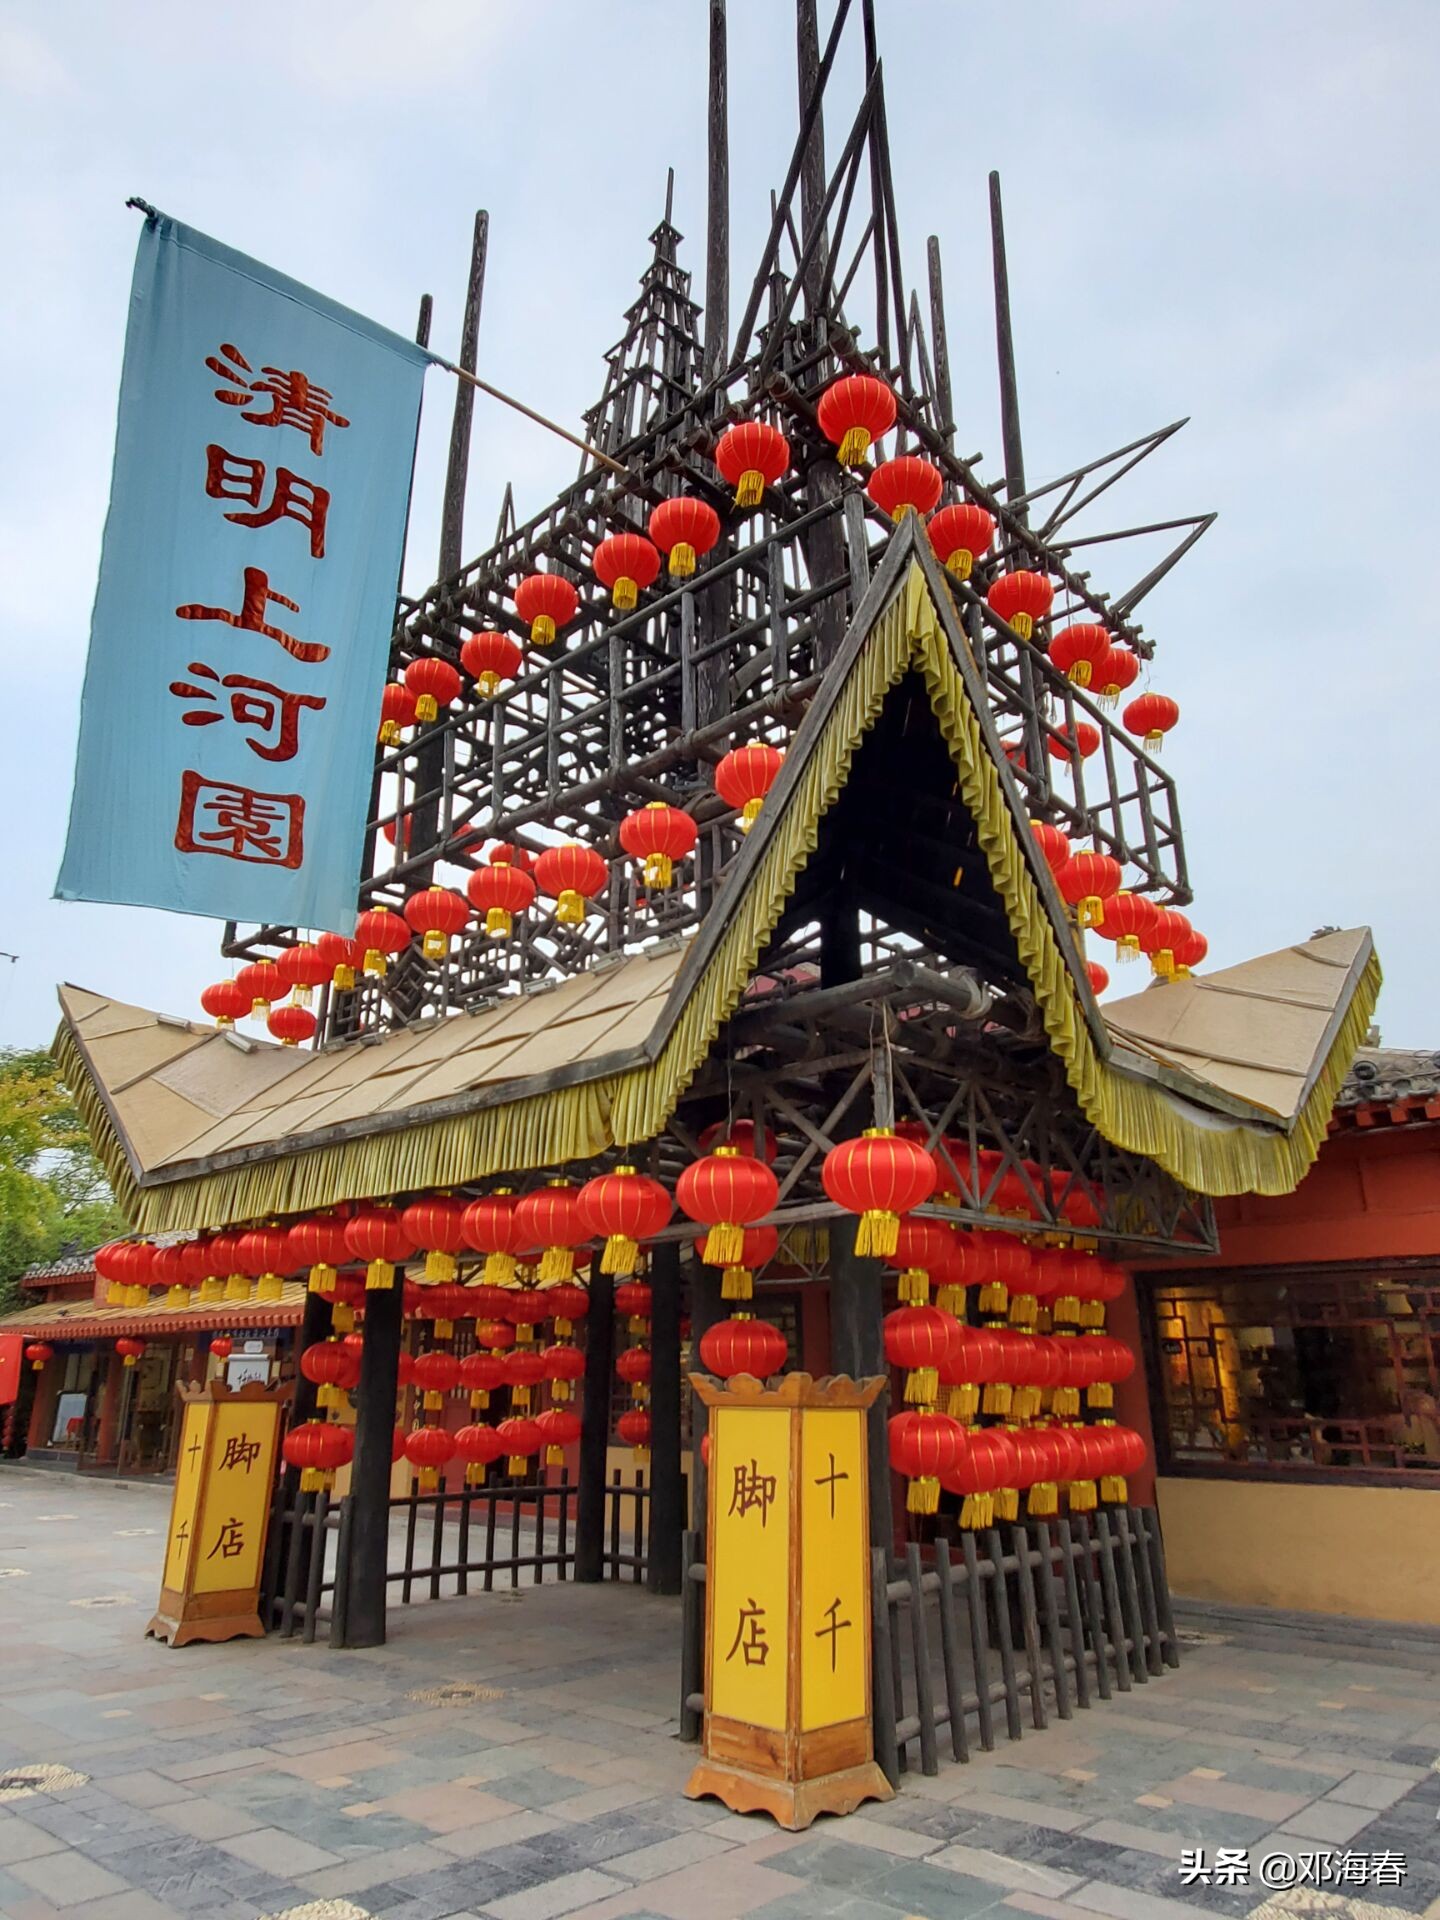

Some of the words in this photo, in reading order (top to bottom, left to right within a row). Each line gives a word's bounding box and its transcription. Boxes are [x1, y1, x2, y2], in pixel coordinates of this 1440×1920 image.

[175, 1434, 202, 1560] 十千
[207, 1433, 261, 1560] 脚店
[726, 1458, 776, 1666] 脚店
[814, 1453, 852, 1673] 十千
